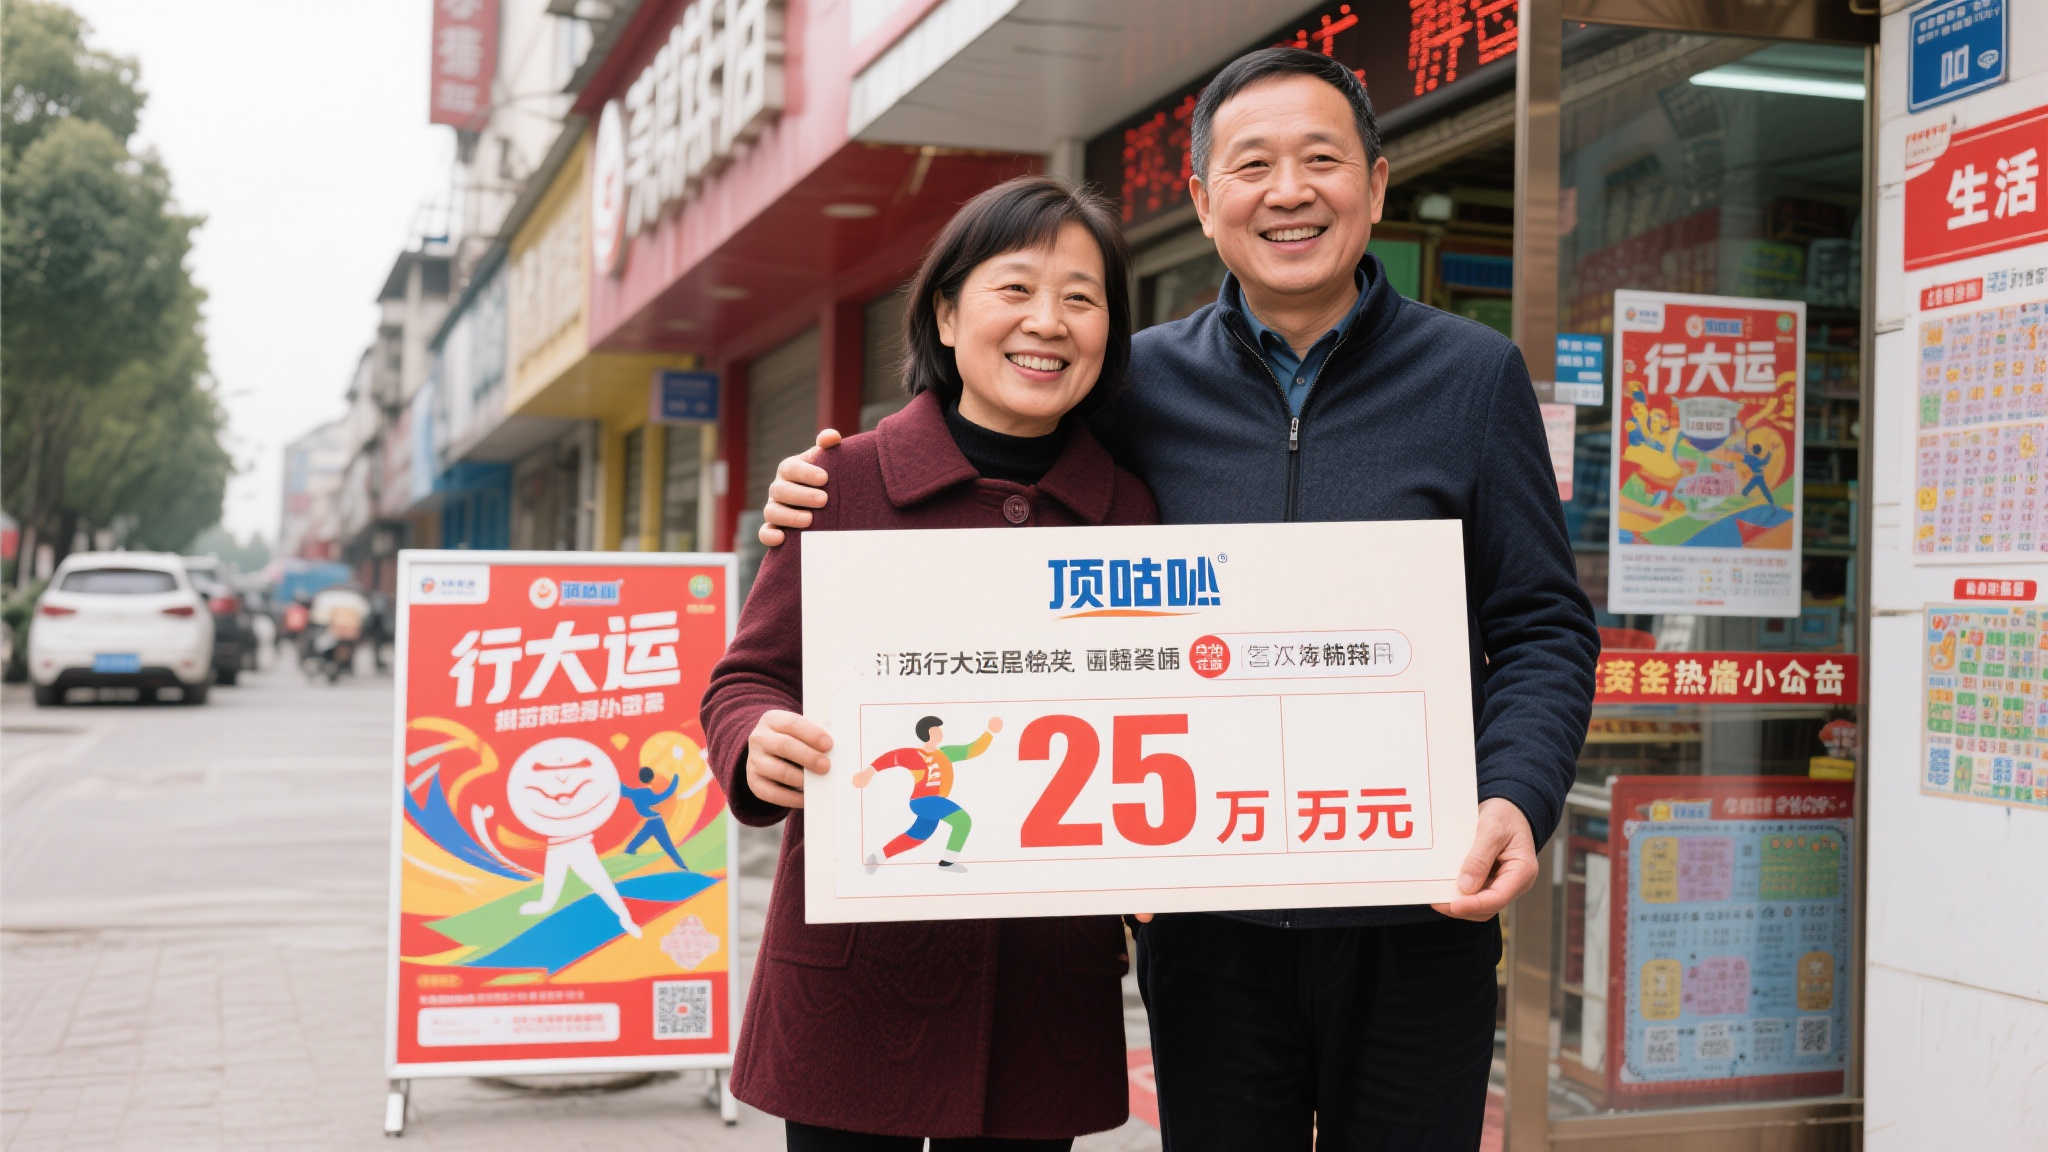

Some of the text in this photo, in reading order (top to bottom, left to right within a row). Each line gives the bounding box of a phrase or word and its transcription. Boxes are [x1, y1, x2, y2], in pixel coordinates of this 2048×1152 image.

[1946, 147, 2039, 231] 生活
[1643, 341, 1777, 395] 行大运
[449, 610, 682, 707] 行大运
[1018, 714, 1197, 848] 25
[1216, 790, 1270, 844] 万
